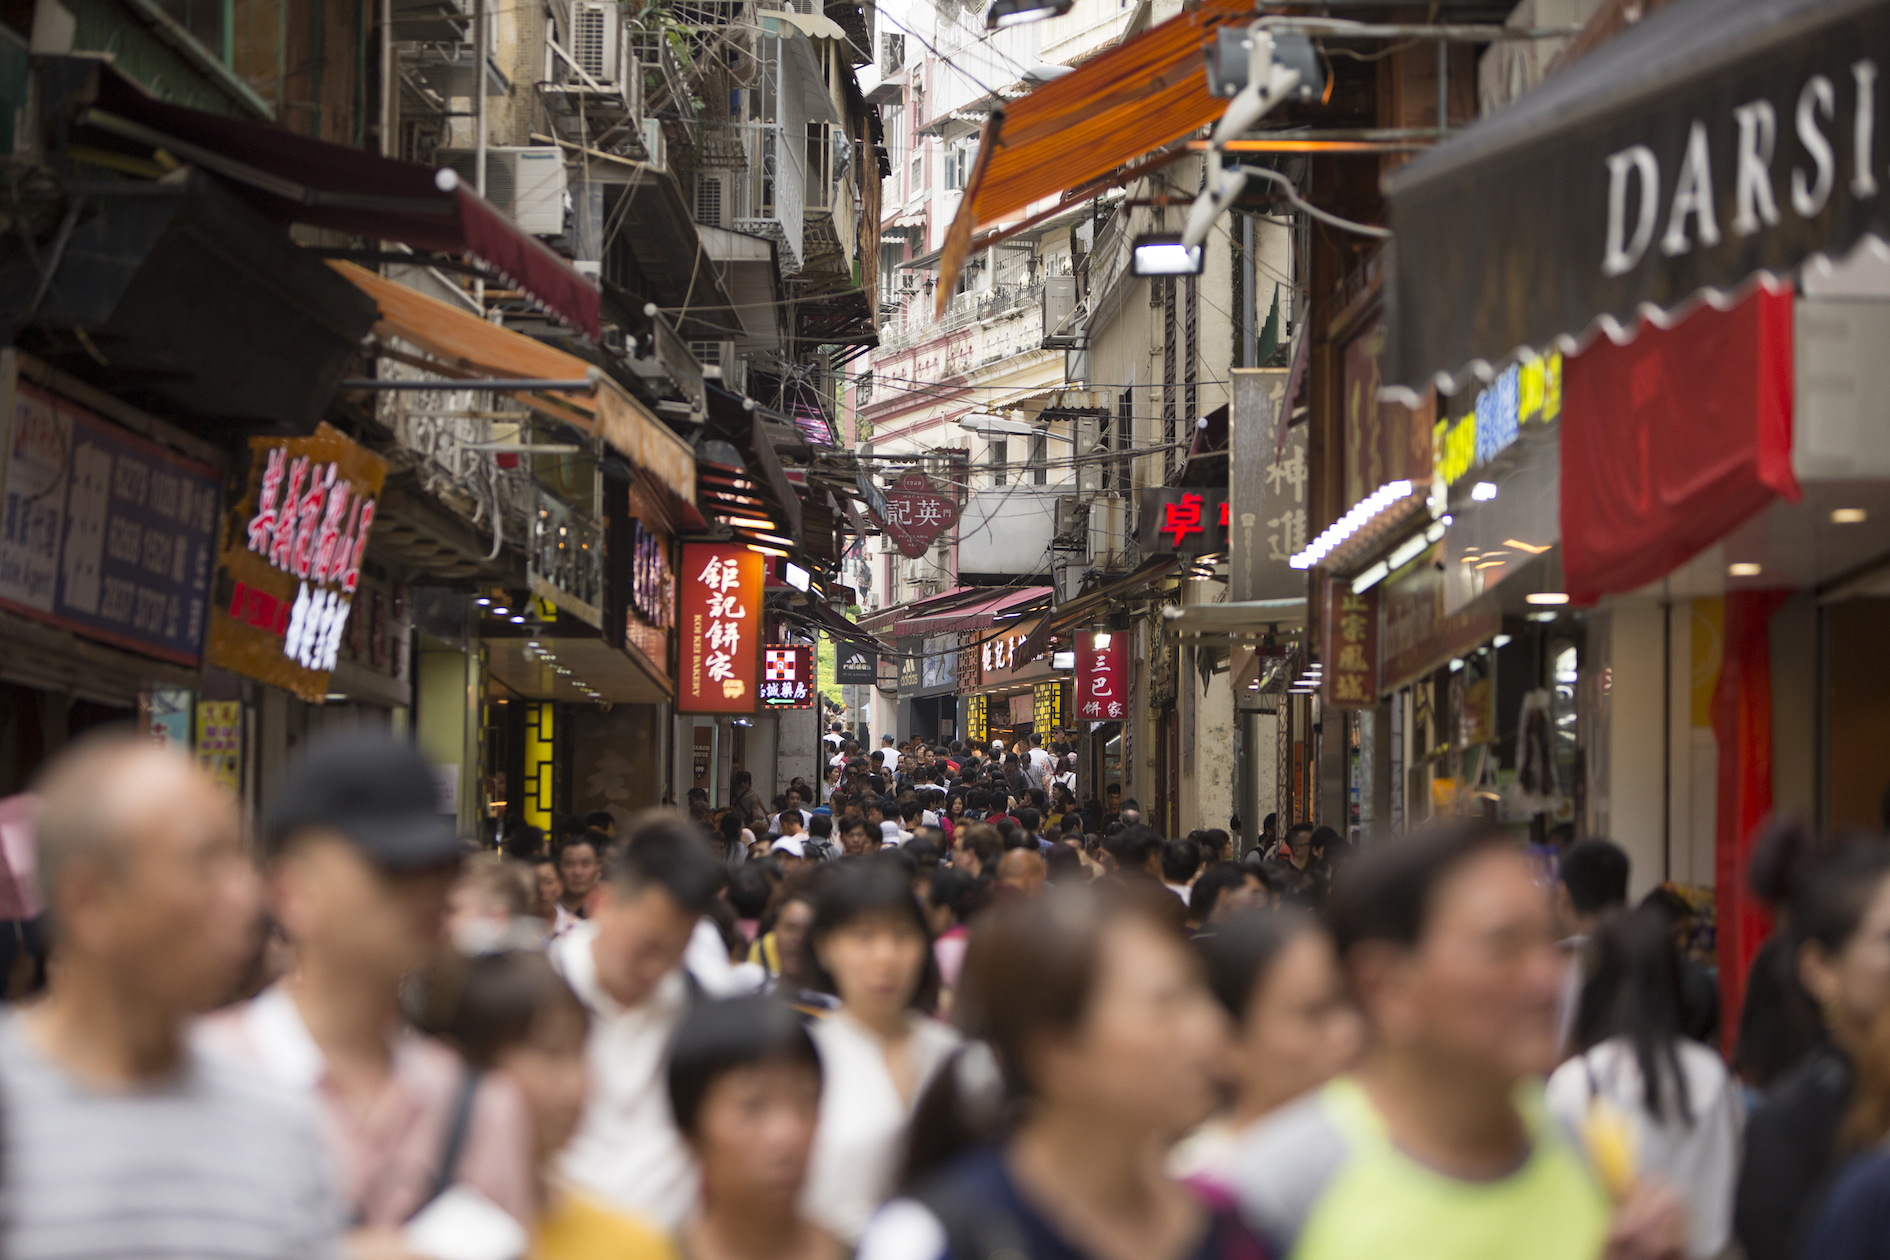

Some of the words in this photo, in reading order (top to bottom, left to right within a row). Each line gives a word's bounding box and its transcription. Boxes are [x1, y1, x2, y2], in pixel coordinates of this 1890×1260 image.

[693, 614, 703, 634] KOI
[697, 555, 747, 683] 鉅記餅家
[692, 636, 702, 655] KEI
[691, 655, 702, 698] BAKERY
[1082, 701, 1123, 718] 餅家
